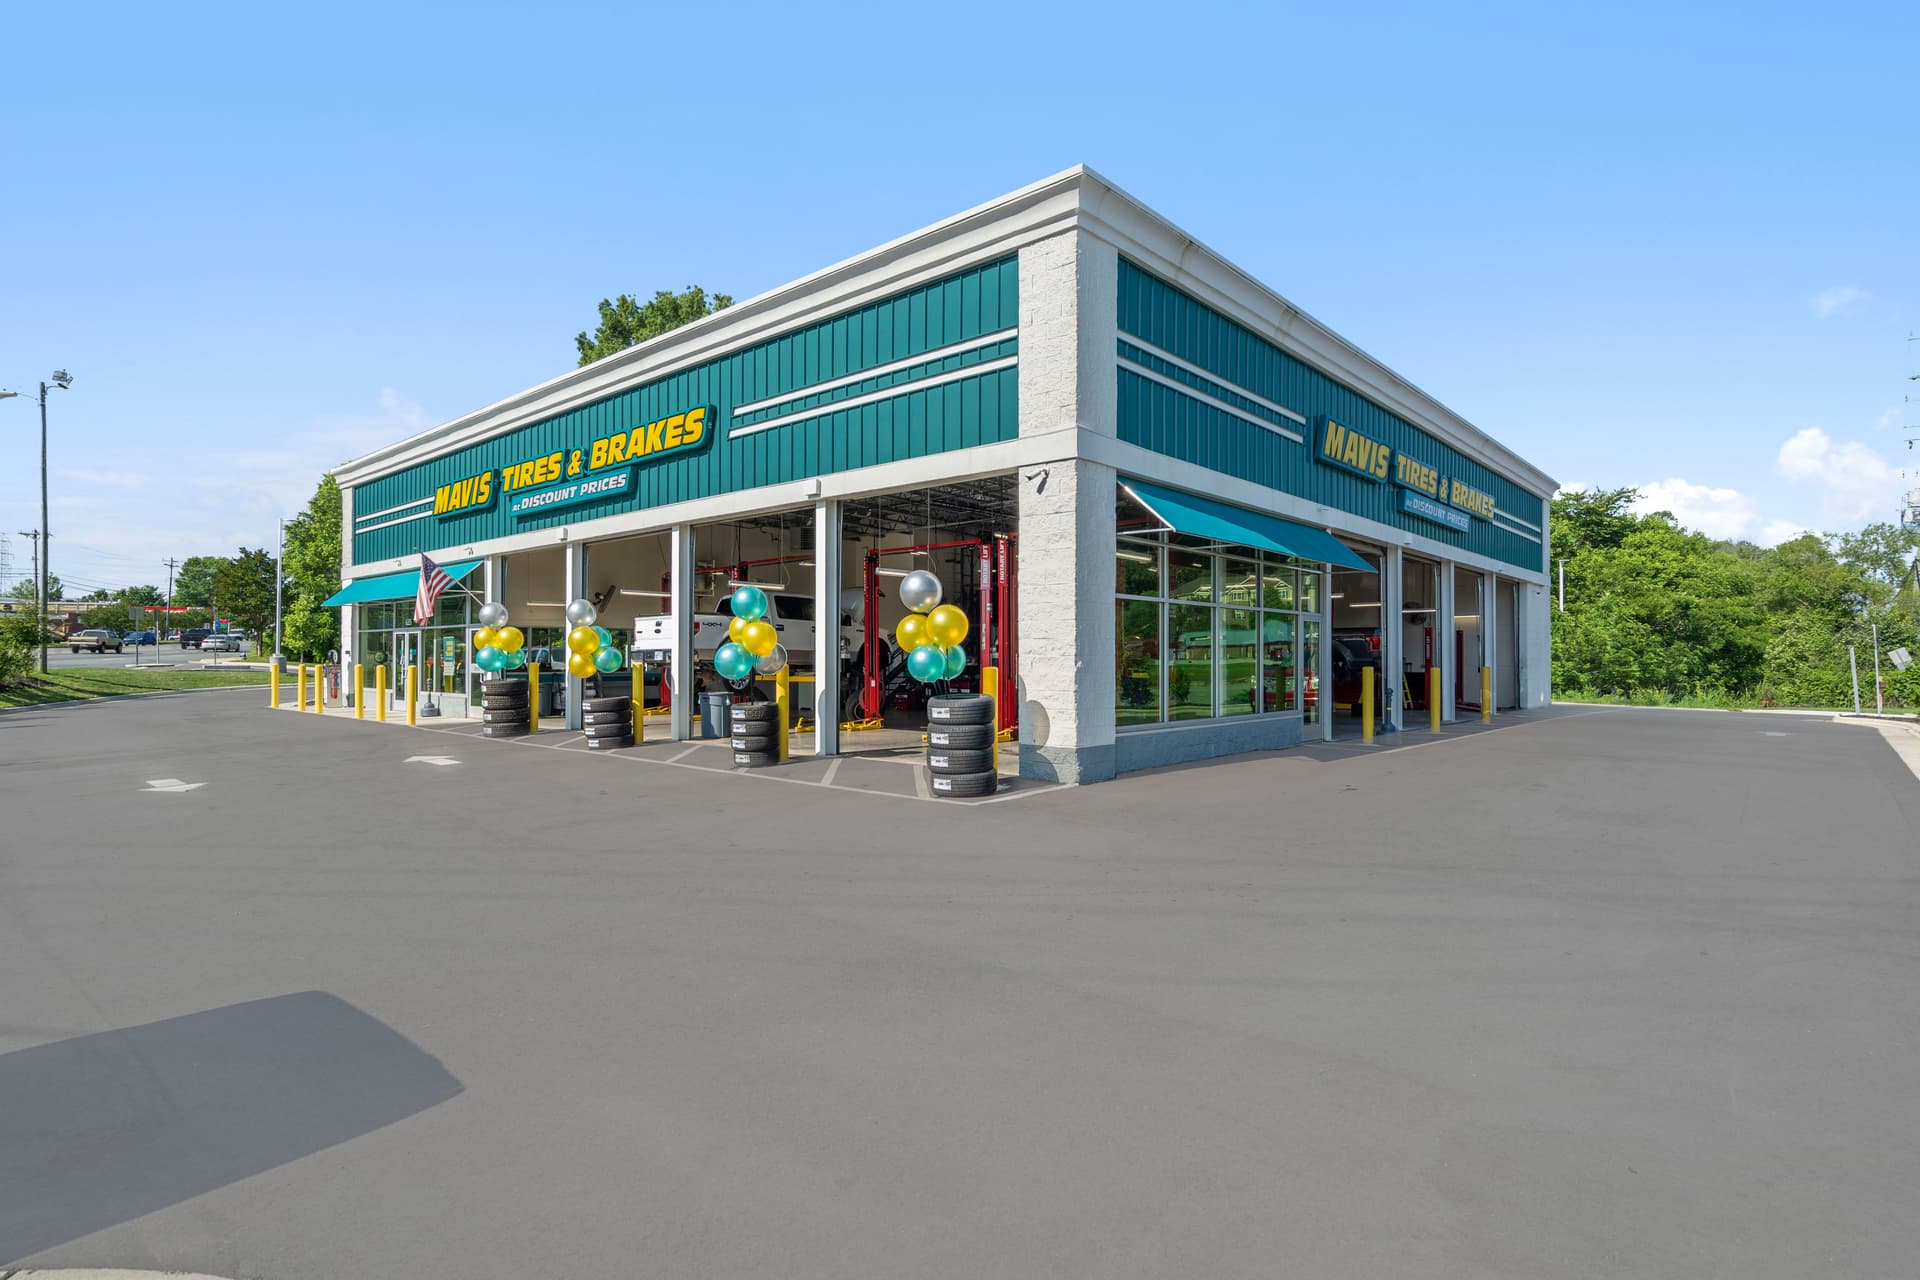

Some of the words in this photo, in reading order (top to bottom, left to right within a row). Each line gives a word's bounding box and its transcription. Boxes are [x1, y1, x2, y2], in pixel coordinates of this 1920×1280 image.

[433, 470, 492, 515] MAVIS
[502, 450, 563, 492] TIRES
[567, 449, 585, 477] &
[590, 407, 705, 470] BRAKES
[521, 486, 578, 509] DISCOUNT
[580, 473, 627, 496] PRICES
[1324, 420, 1390, 479] MAVIS
[1397, 453, 1438, 498] TIRES
[1439, 477, 1449, 500] &
[1452, 479, 1495, 519] BRAKES
[1413, 498, 1446, 519] DISCOUNT
[1447, 511, 1468, 528] PRICES
